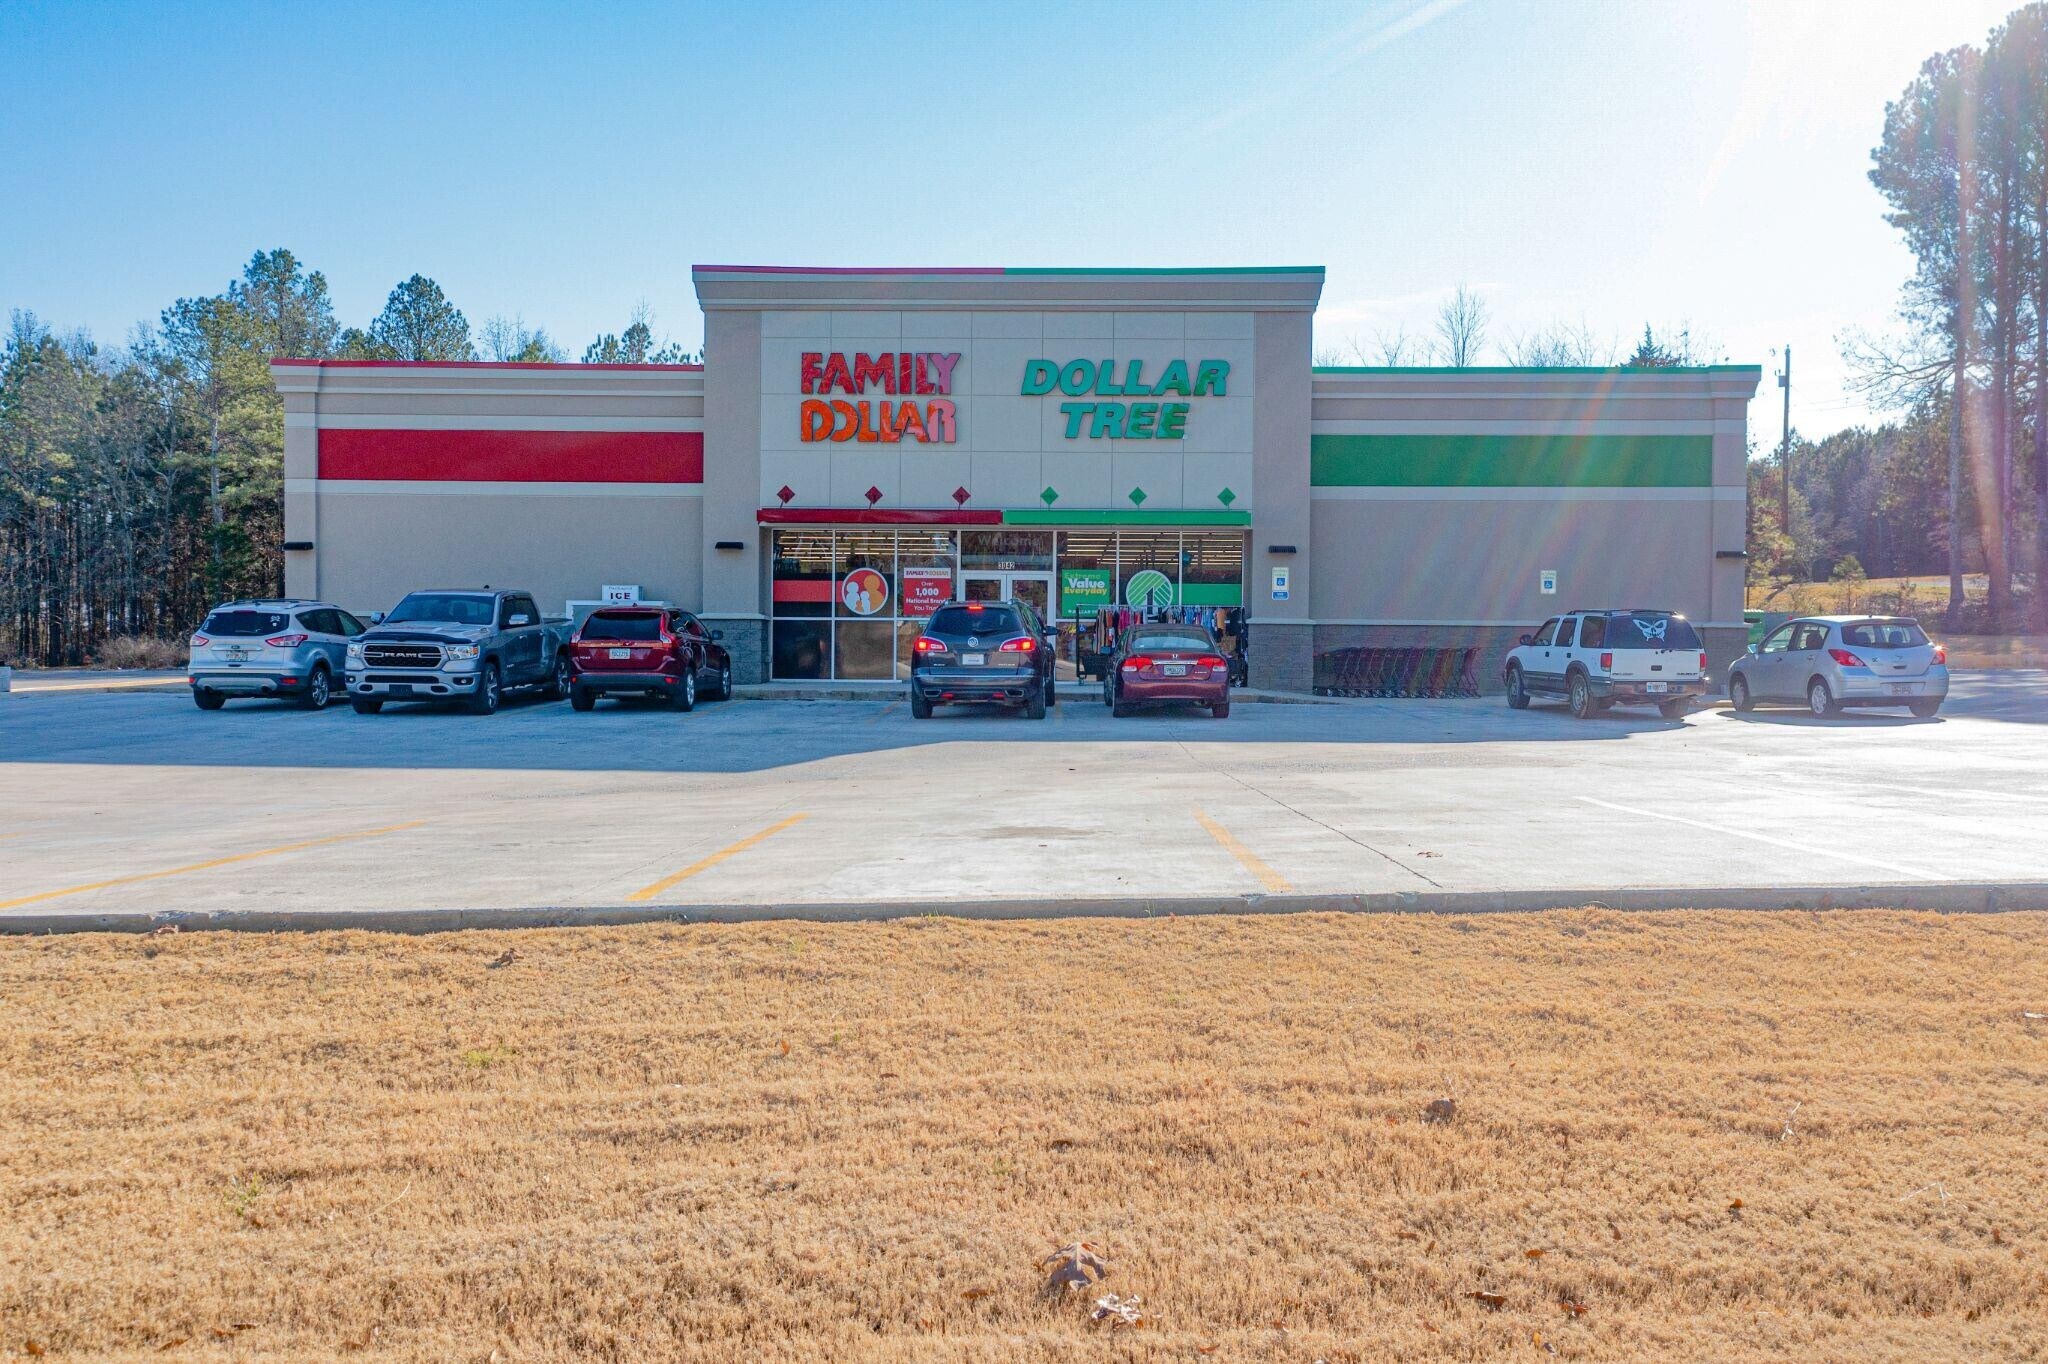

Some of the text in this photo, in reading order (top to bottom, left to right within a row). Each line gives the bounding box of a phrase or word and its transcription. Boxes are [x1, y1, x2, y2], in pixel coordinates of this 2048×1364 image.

[801, 352, 962, 395] FAMILY
[1021, 358, 1232, 397] DOLLAR
[801, 399, 957, 443] DOLLAR
[1060, 403, 1191, 439] TREE
[915, 587, 939, 597] 1,000
[1064, 587, 1108, 596] Everyday
[1068, 577, 1106, 589] Value
[610, 592, 631, 600] ICE
